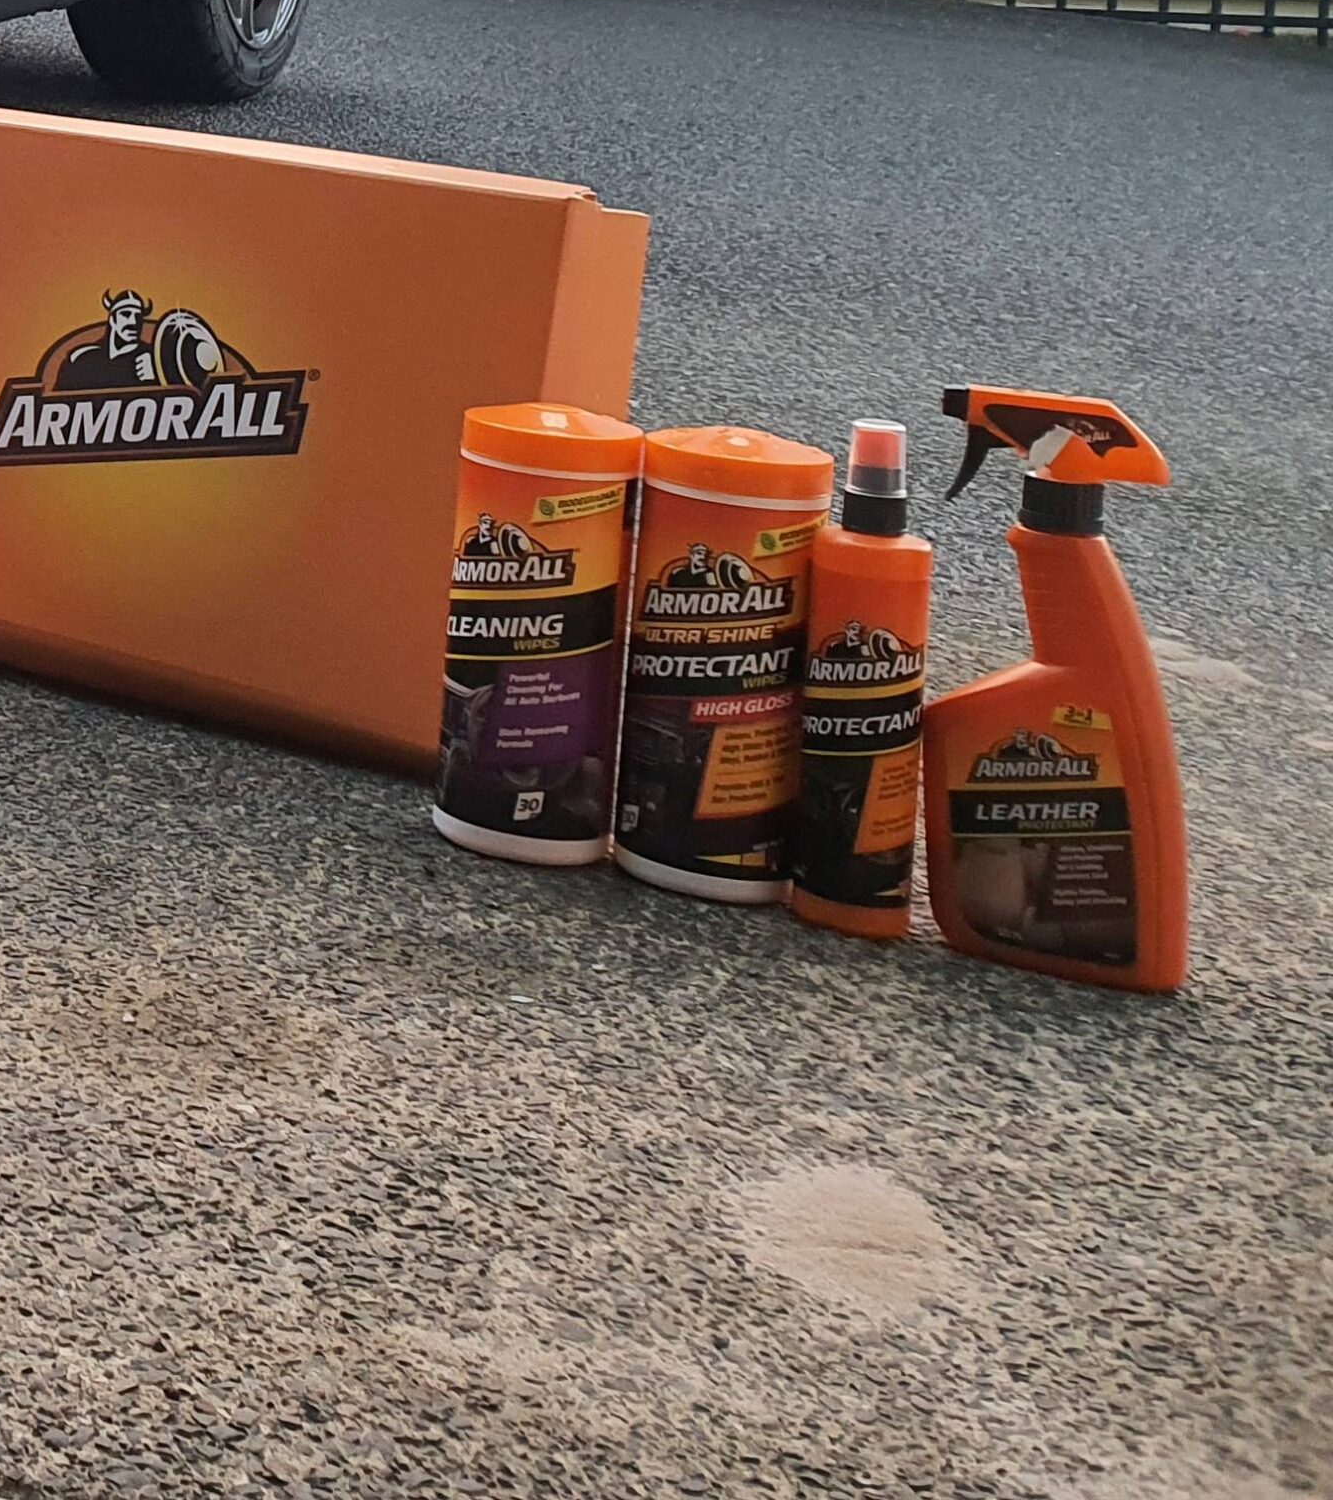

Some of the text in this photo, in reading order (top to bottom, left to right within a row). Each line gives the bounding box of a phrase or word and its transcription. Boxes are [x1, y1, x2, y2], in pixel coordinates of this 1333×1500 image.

[447, 613, 565, 638] CLEANING
[645, 624, 775, 644] ULTRA SHINE
[513, 637, 561, 651] WIPES
[633, 647, 795, 678] PROTECTANT
[742, 674, 788, 690] WIPES
[695, 692, 793, 716] HIGH GLOSS
[517, 797, 540, 812] 30
[975, 802, 1100, 821] LEATHER
